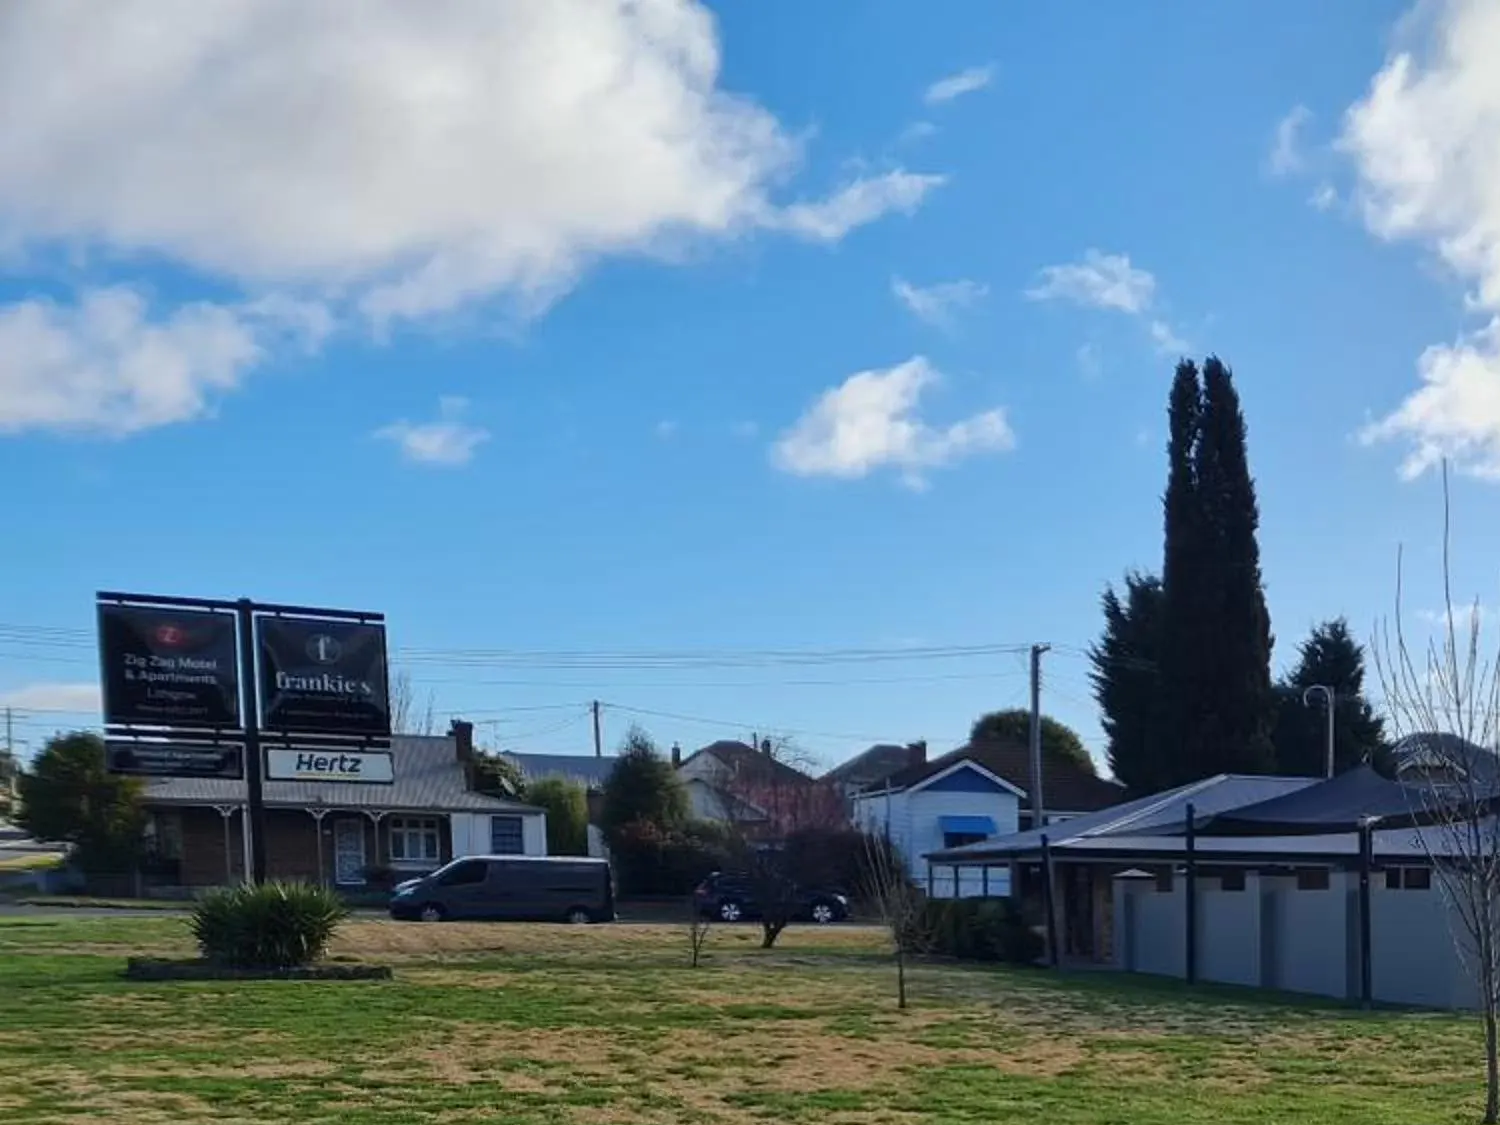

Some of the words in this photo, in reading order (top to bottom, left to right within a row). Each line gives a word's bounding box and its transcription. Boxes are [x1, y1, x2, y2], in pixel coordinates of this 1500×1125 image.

[123, 652, 148, 669] Zig
[178, 656, 219, 670] Motel
[138, 669, 219, 686] Apartments
[295, 753, 362, 773] Hertz
